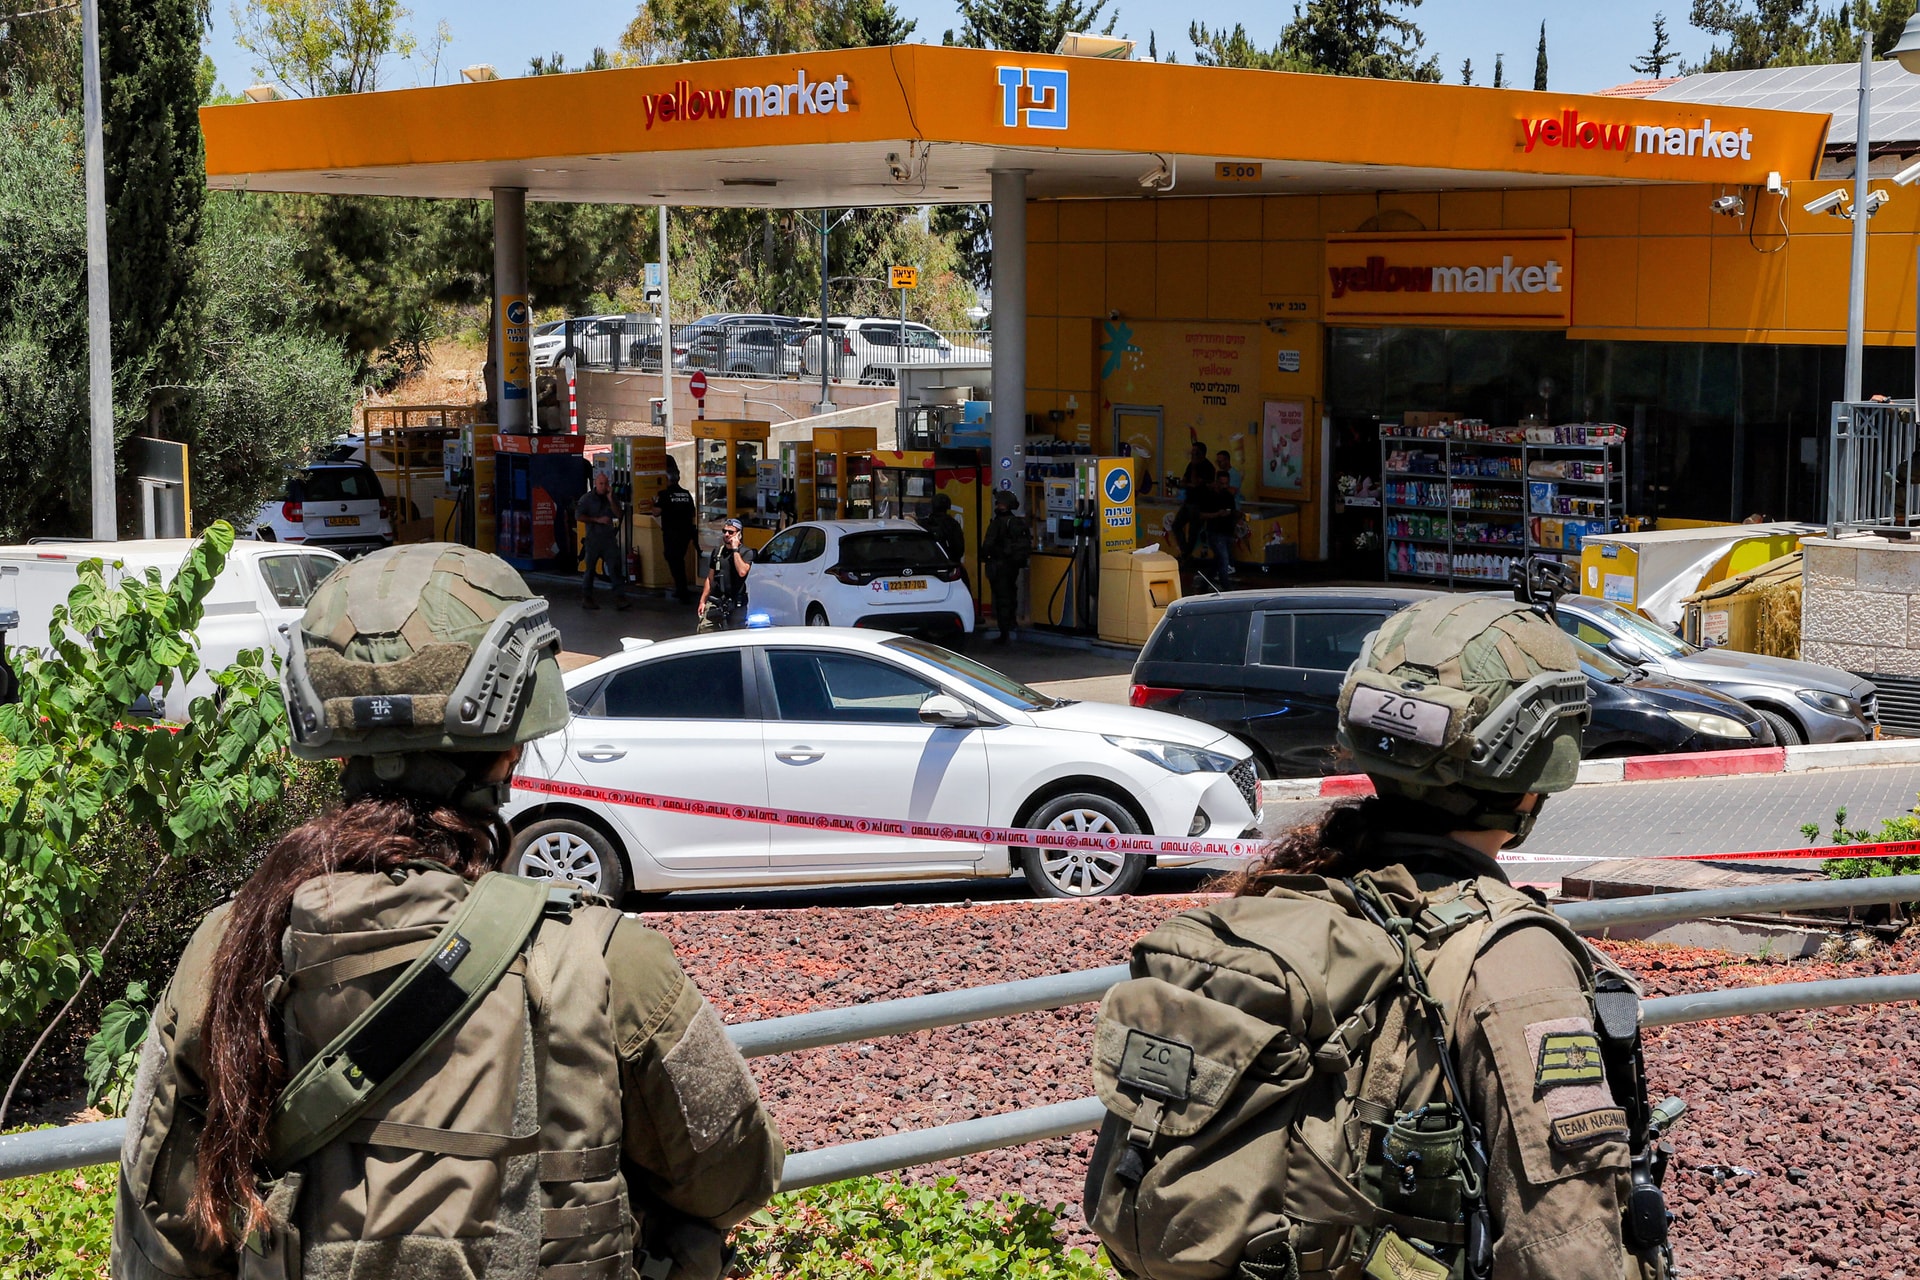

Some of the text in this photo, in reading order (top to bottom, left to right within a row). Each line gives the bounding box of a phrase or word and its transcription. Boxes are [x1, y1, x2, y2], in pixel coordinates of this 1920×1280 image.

[996, 65, 1070, 130] פז
[1222, 166, 1256, 177] 5.00
[893, 269, 915, 279] יציאה
[1268, 302, 1307, 311] כוכב יאיר
[1198, 363, 1233, 377] yellow
[1190, 382, 1240, 395] ומקבלים כסף
[1202, 396, 1227, 406] בחזרה
[1105, 507, 1133, 517] שירות
[1107, 517, 1131, 527] עצמי
[1378, 695, 1417, 719] Z.C
[786, 814, 815, 827] משטרת
[830, 818, 855, 832] ישראל
[871, 822, 883, 833] אין
[883, 823, 904, 834] מעבר
[911, 825, 939, 838] משטרת
[954, 828, 979, 841] ישראל
[996, 831, 1008, 842] אין
[1008, 834, 1028, 844] מעבר
[1036, 835, 1064, 846] משטרת
[1079, 837, 1104, 850] ישראל
[1121, 838, 1132, 849] אין
[1133, 840, 1153, 850] מעבר
[1160, 842, 1189, 852] משטרת
[1203, 844, 1228, 856] ישראל
[1847, 847, 1877, 855] משטרת
[1884, 846, 1905, 854] מעבר
[1142, 1042, 1171, 1065] Z.C
[1557, 1119, 1590, 1137] TEAM
